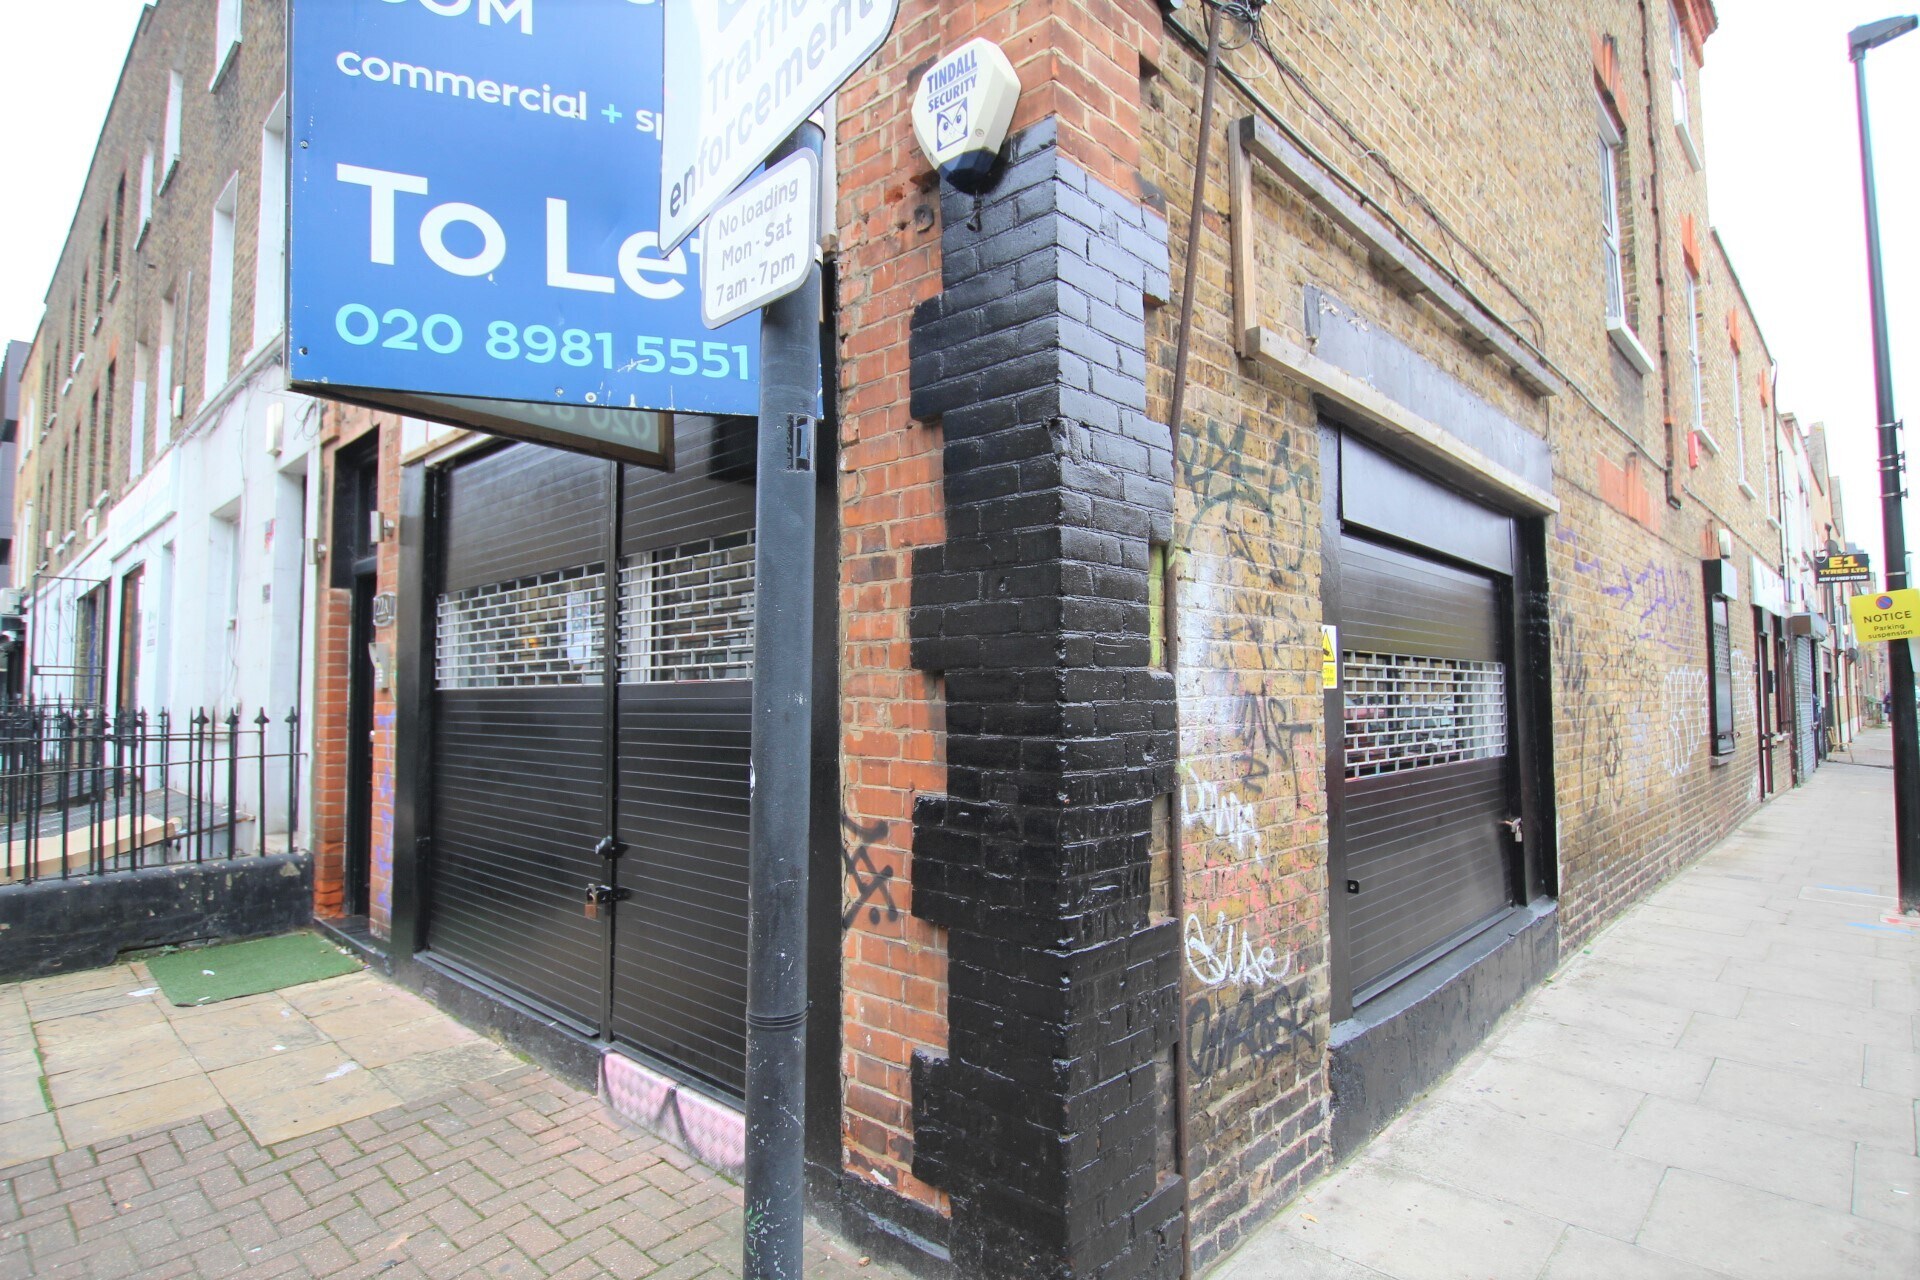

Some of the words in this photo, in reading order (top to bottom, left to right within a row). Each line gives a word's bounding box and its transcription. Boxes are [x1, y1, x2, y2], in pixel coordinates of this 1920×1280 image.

[336, 51, 587, 120] commercial
[927, 49, 977, 94] TINDALL
[928, 74, 977, 113] SECURITY
[336, 163, 506, 276] To
[546, 197, 704, 300] Le
[718, 214, 739, 240] No
[742, 178, 798, 226] loading
[722, 240, 752, 271] Mon
[764, 213, 792, 248] Sat
[716, 277, 748, 306] 7am
[758, 252, 795, 285] 7pm
[335, 303, 463, 354] 020
[485, 321, 613, 370] 8981
[636, 335, 749, 380] 5551
[1819, 567, 1849, 575] TYRES
[1829, 555, 1859, 568] E1
[1863, 610, 1912, 623] NOTICE
[1868, 630, 1913, 639] suspension
